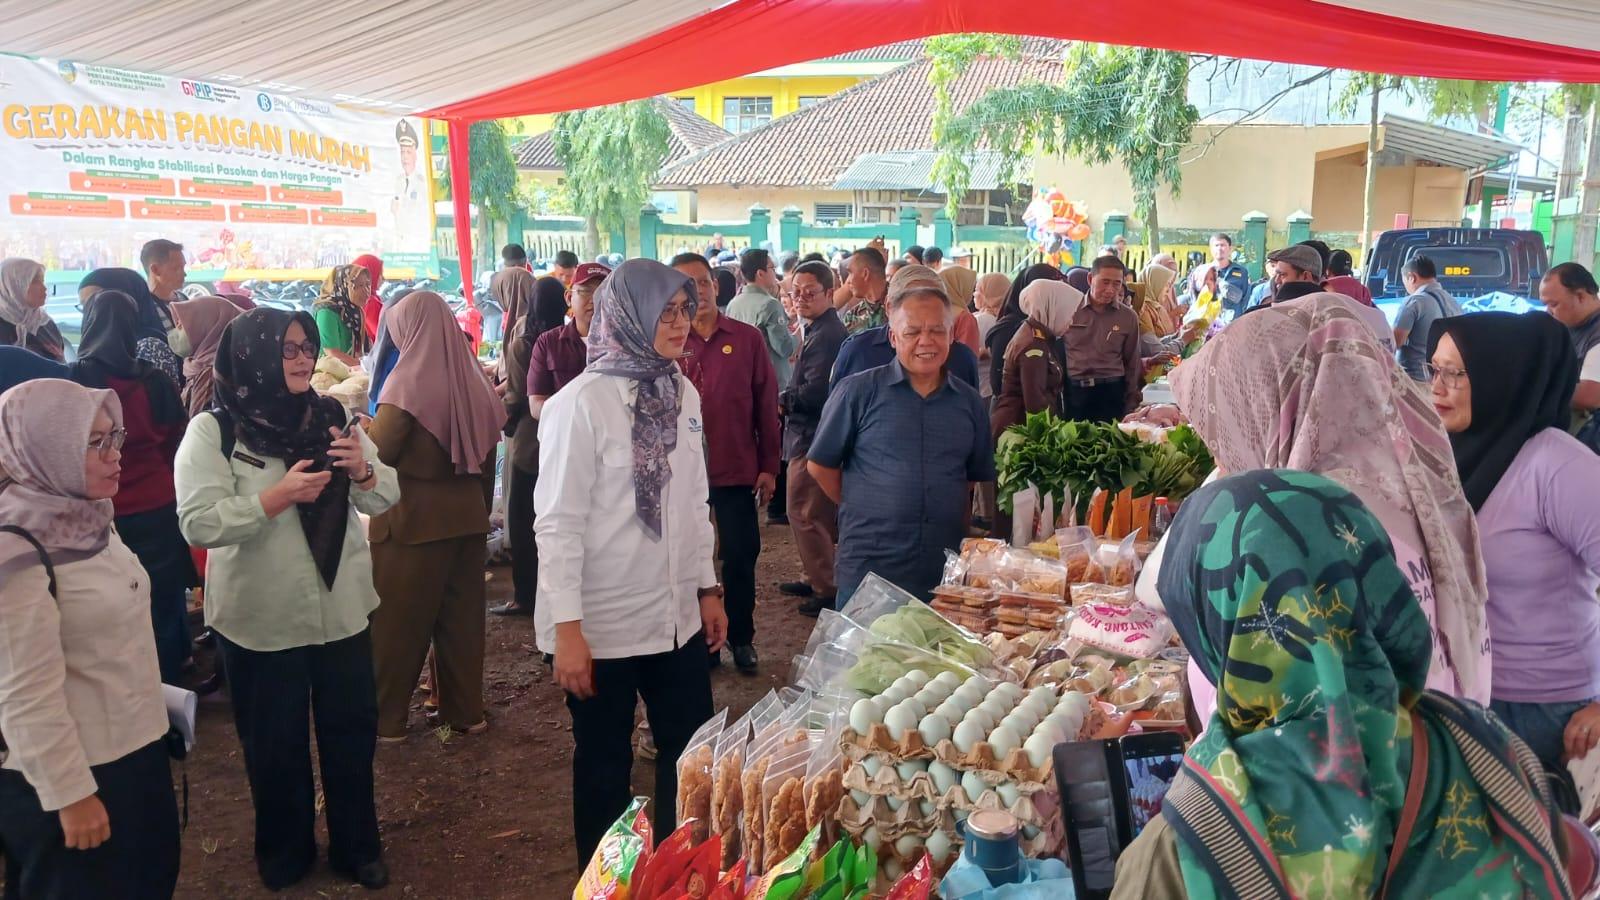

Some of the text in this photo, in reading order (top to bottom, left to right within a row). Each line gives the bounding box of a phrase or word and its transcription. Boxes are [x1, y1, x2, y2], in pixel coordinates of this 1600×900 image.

[2, 103, 371, 173] GERAKAN PANGAN MURAH
[62, 151, 342, 186] Dalam Rangka Stabilisasi Pasokan dan Harga Pangan
[1445, 266, 1470, 275] BBC
